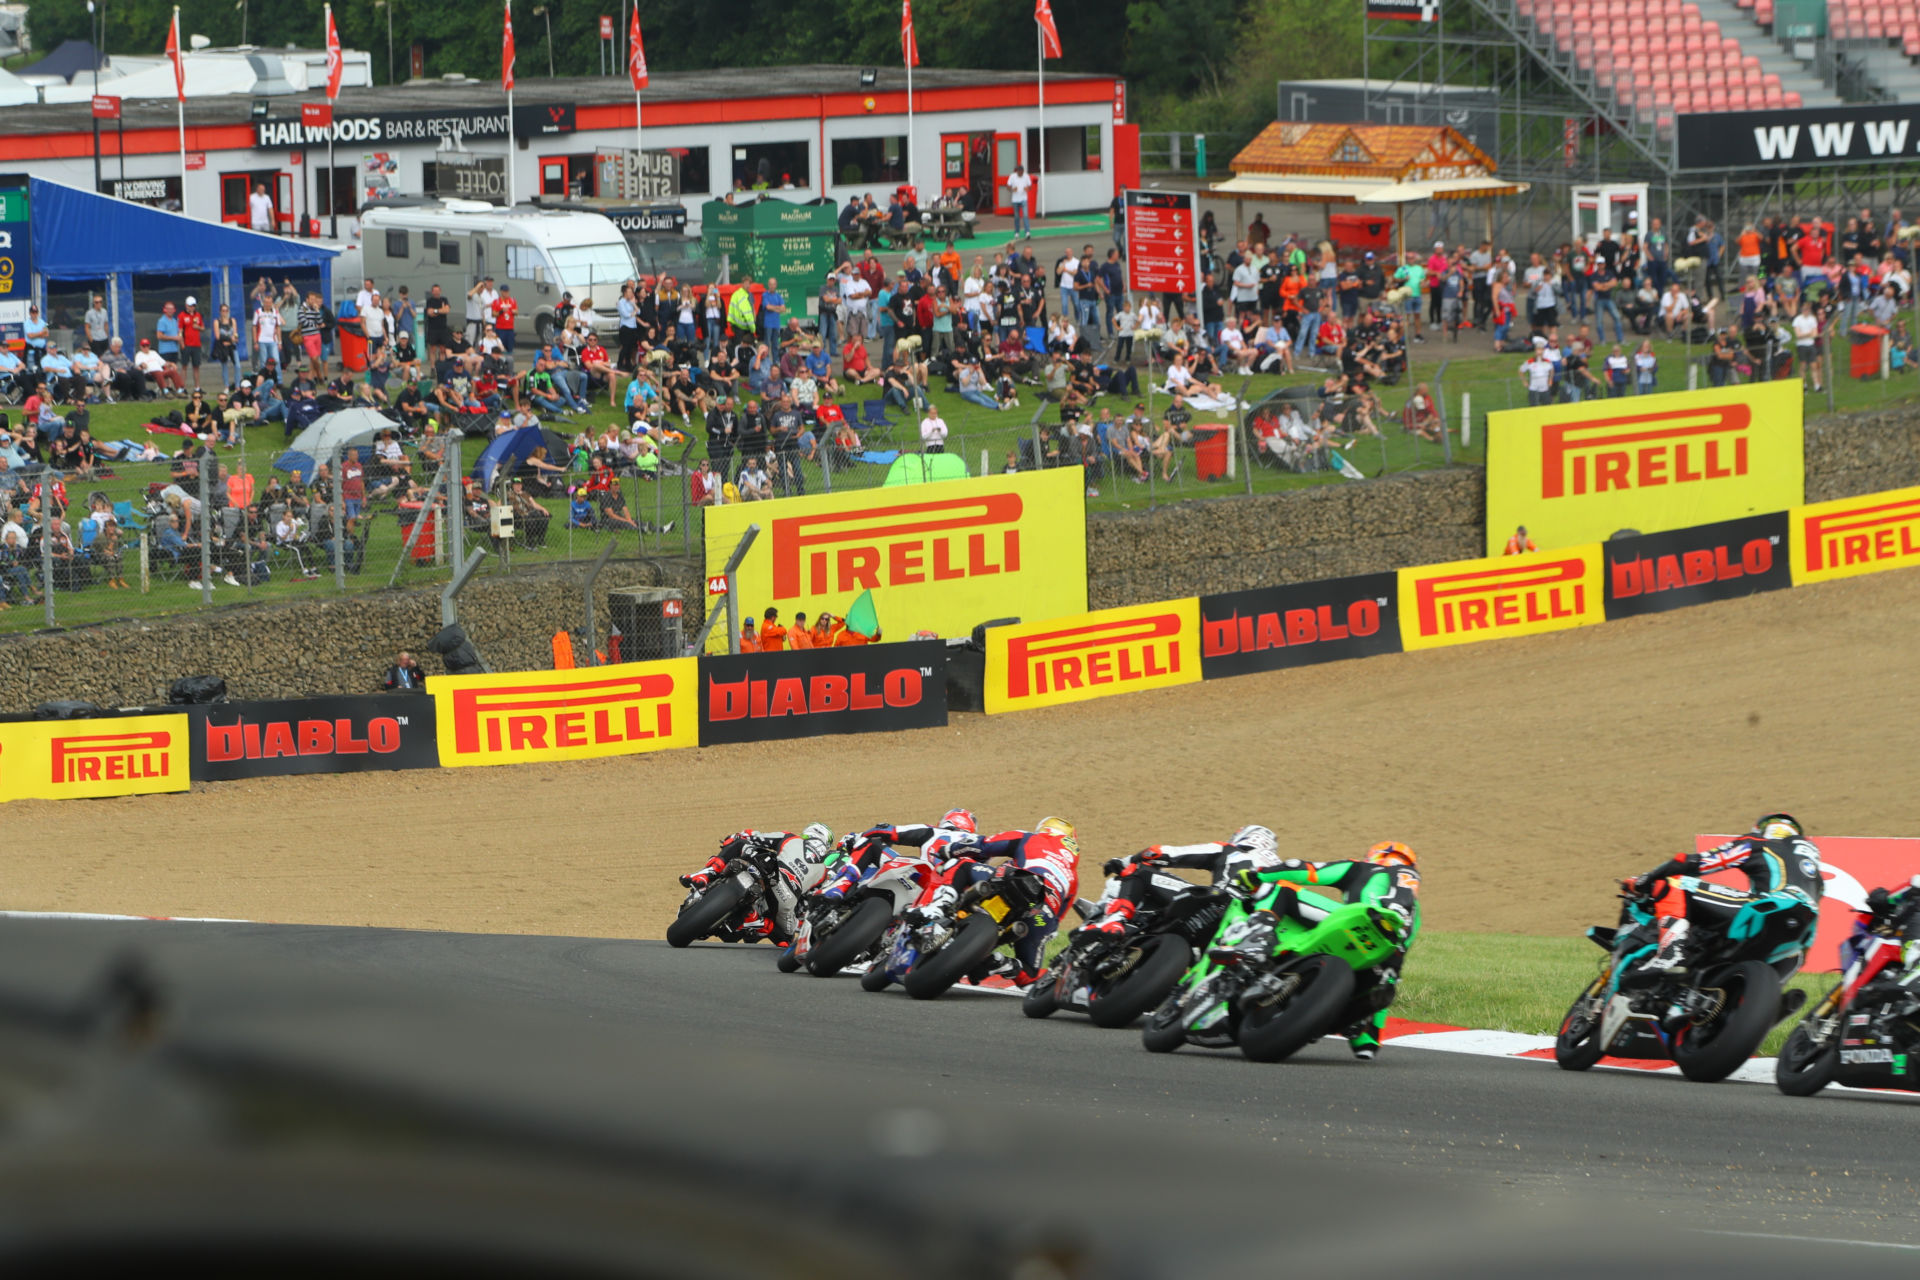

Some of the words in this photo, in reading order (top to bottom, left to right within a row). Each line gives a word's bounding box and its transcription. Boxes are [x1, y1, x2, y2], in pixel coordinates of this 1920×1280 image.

[260, 117, 381, 145] HAILWOODS
[385, 119, 412, 139] BAR
[415, 119, 426, 137] &
[427, 114, 511, 136] RESTAURANT
[115, 190, 166, 199] EPERIENCES
[781, 211, 812, 221] MAGNUM
[613, 215, 651, 230] FOOD
[782, 242, 811, 251] VEGAN
[780, 262, 815, 273] MAGNUM
[1542, 403, 1751, 499] PIRELLI
[772, 492, 1023, 600] PIRELLI
[1611, 538, 1773, 599] DIABLO
[710, 578, 727, 592] 4A
[1415, 557, 1586, 637] PIRELLI
[1202, 599, 1380, 658] DIABLO
[1007, 613, 1182, 699] PIRELLI
[452, 673, 674, 754] PIRELLI
[709, 668, 923, 722] DIABLO
[51, 731, 170, 784] PIRELLI
[205, 714, 401, 762] DIABLO
